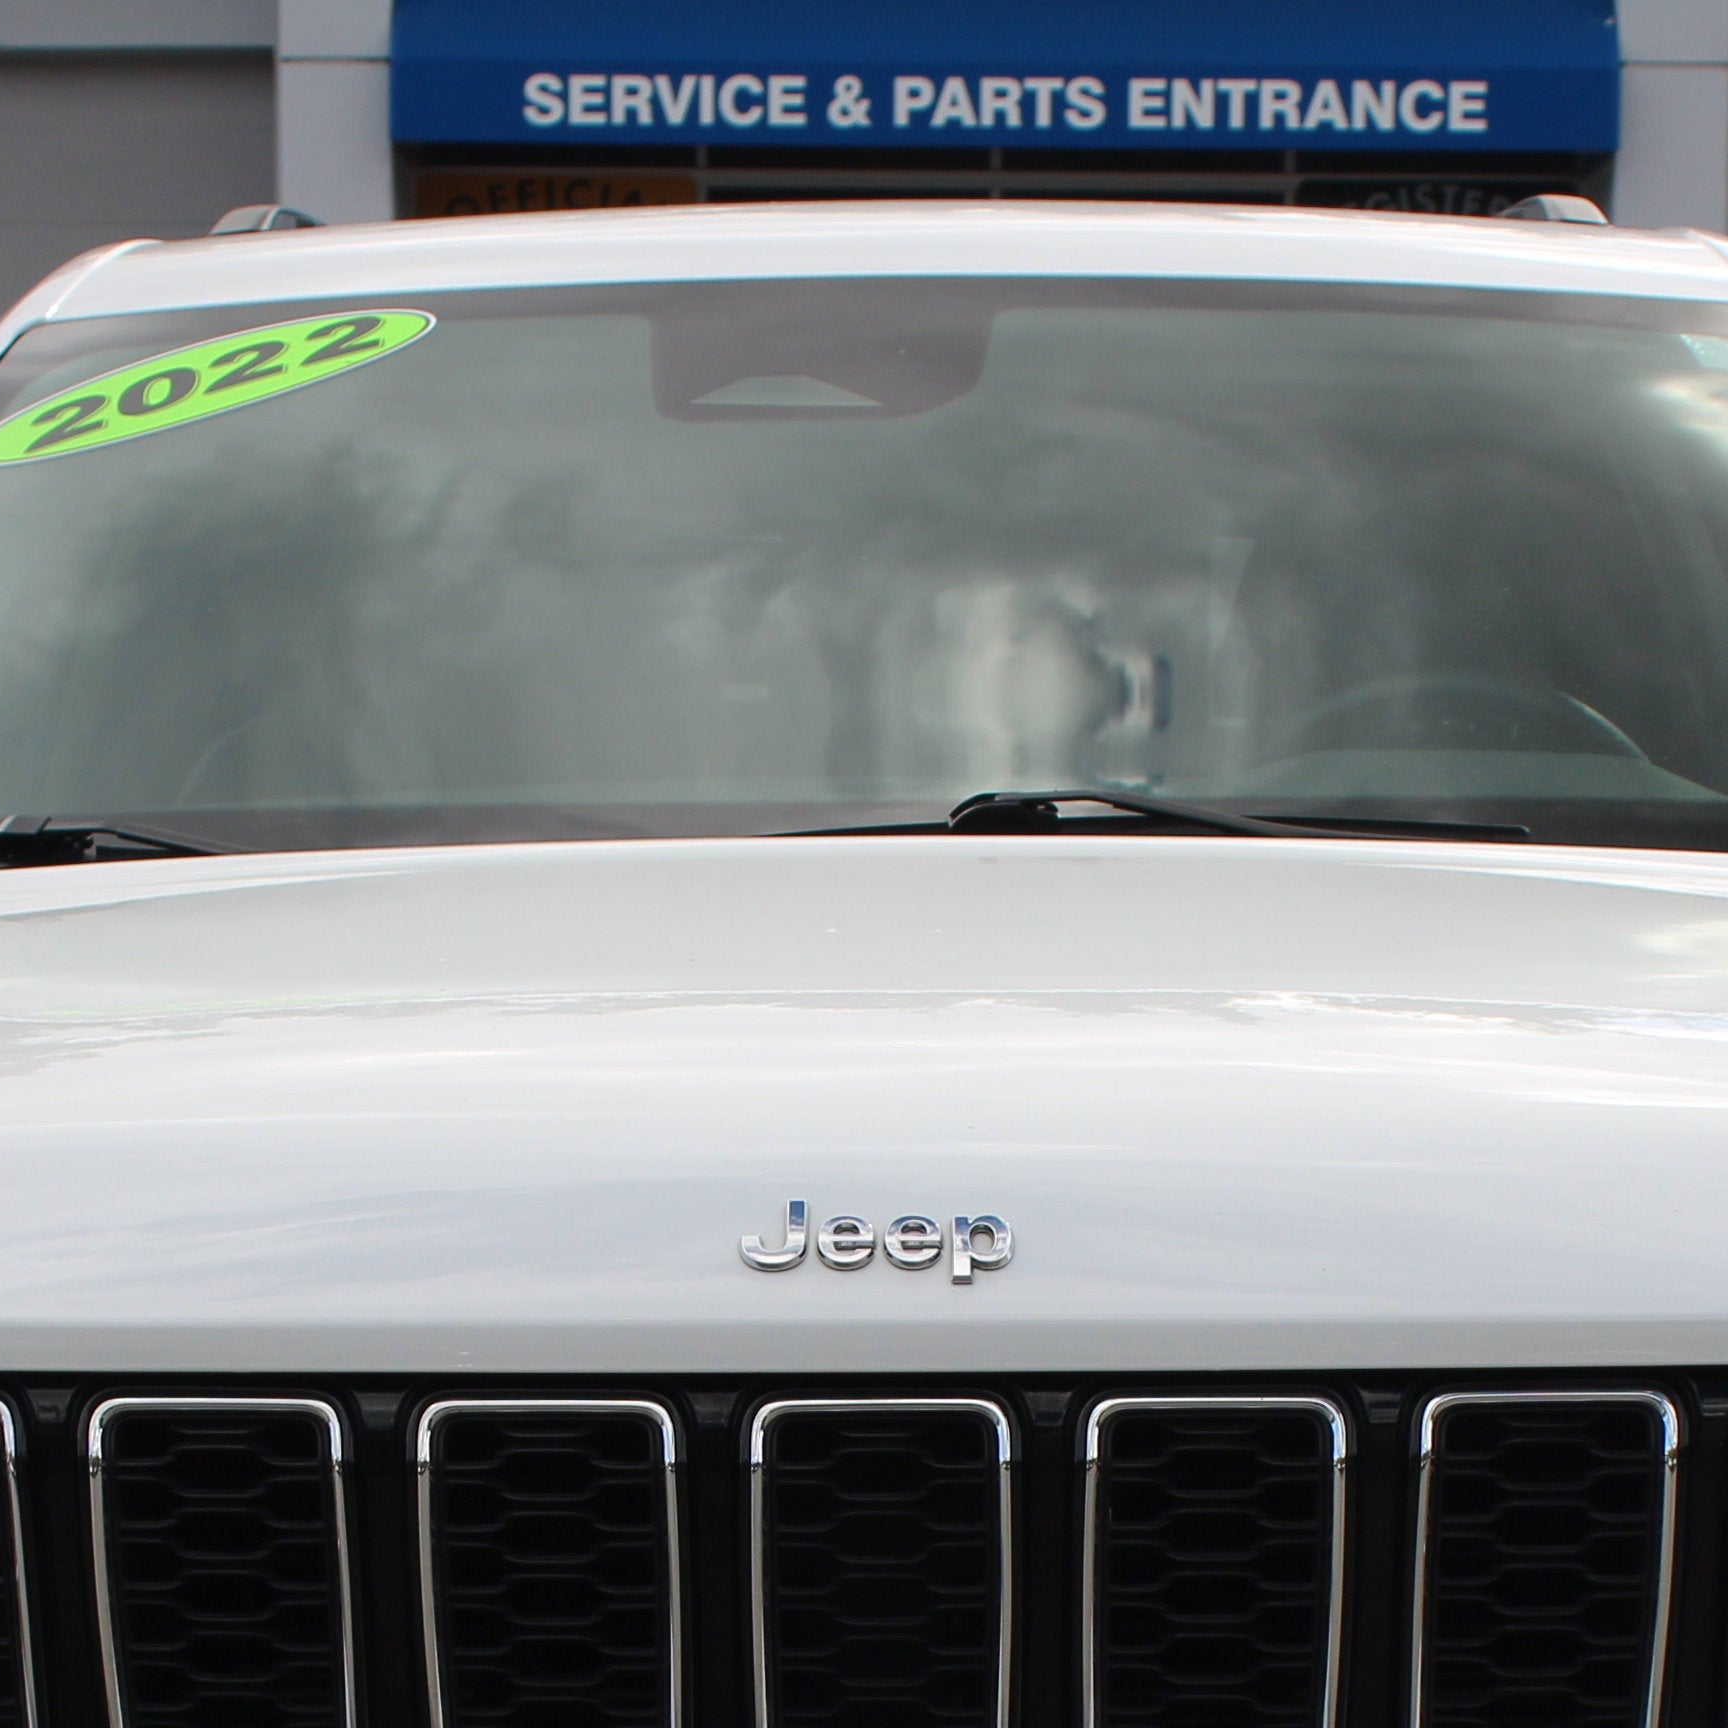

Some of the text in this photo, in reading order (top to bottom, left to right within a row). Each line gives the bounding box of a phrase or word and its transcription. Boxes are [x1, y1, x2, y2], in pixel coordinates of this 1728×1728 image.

[522, 73, 1489, 132] SERVICE & PARTS ENTRANCE
[23, 314, 385, 455] 2022
[738, 1198, 1016, 1285] Jeep
